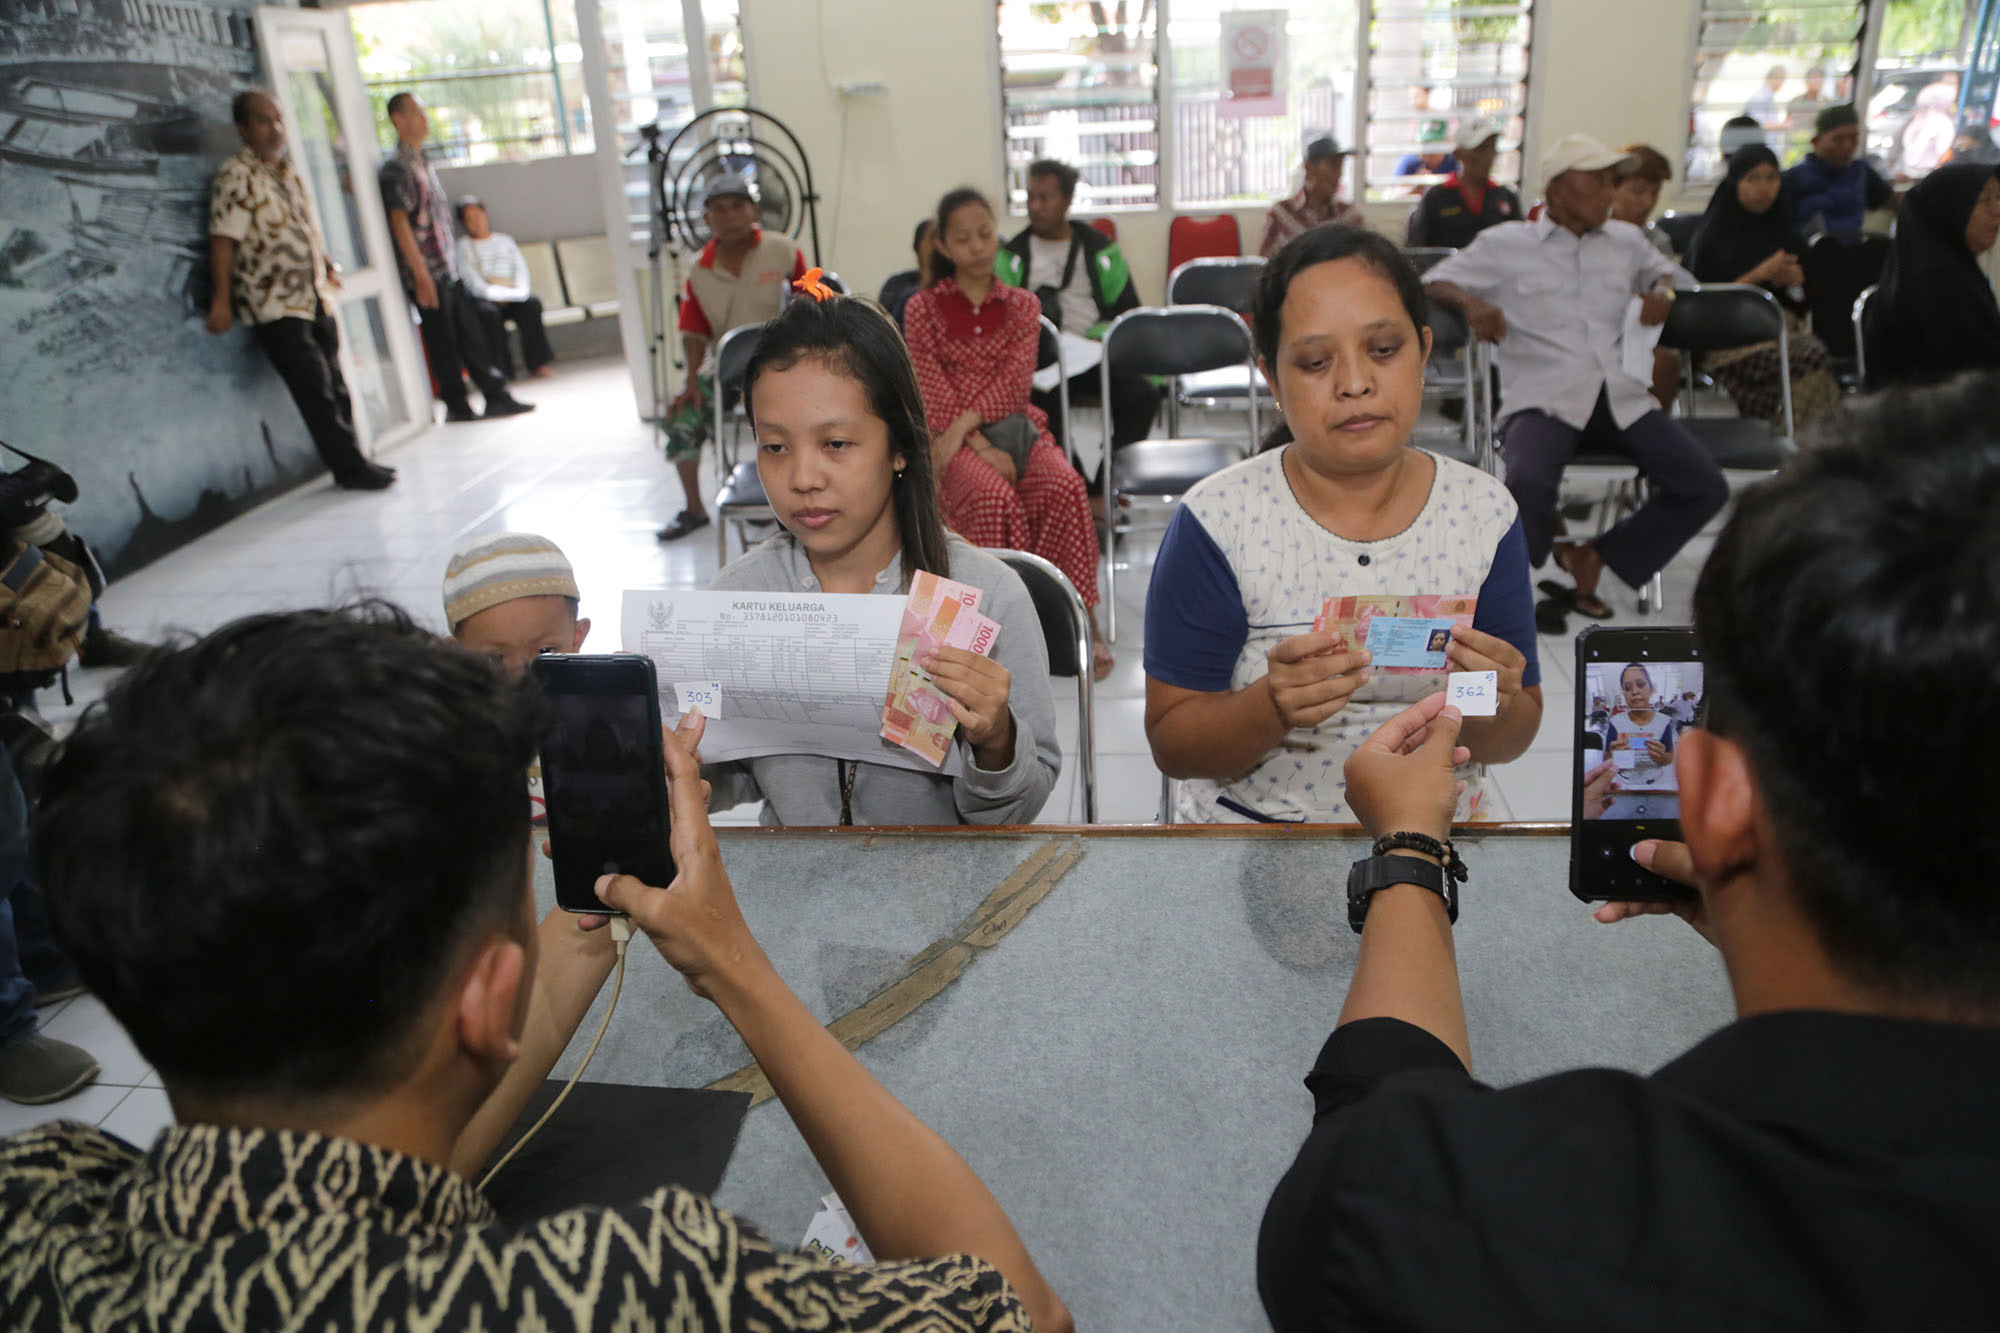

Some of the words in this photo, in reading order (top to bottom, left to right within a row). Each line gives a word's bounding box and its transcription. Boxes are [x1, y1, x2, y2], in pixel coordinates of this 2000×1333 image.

[732, 601, 767, 611] KARTU
[768, 602, 825, 612] KELUARGA
[719, 612, 736, 621] No.
[686, 690, 713, 705] 303
[1455, 685, 1486, 699] 362
